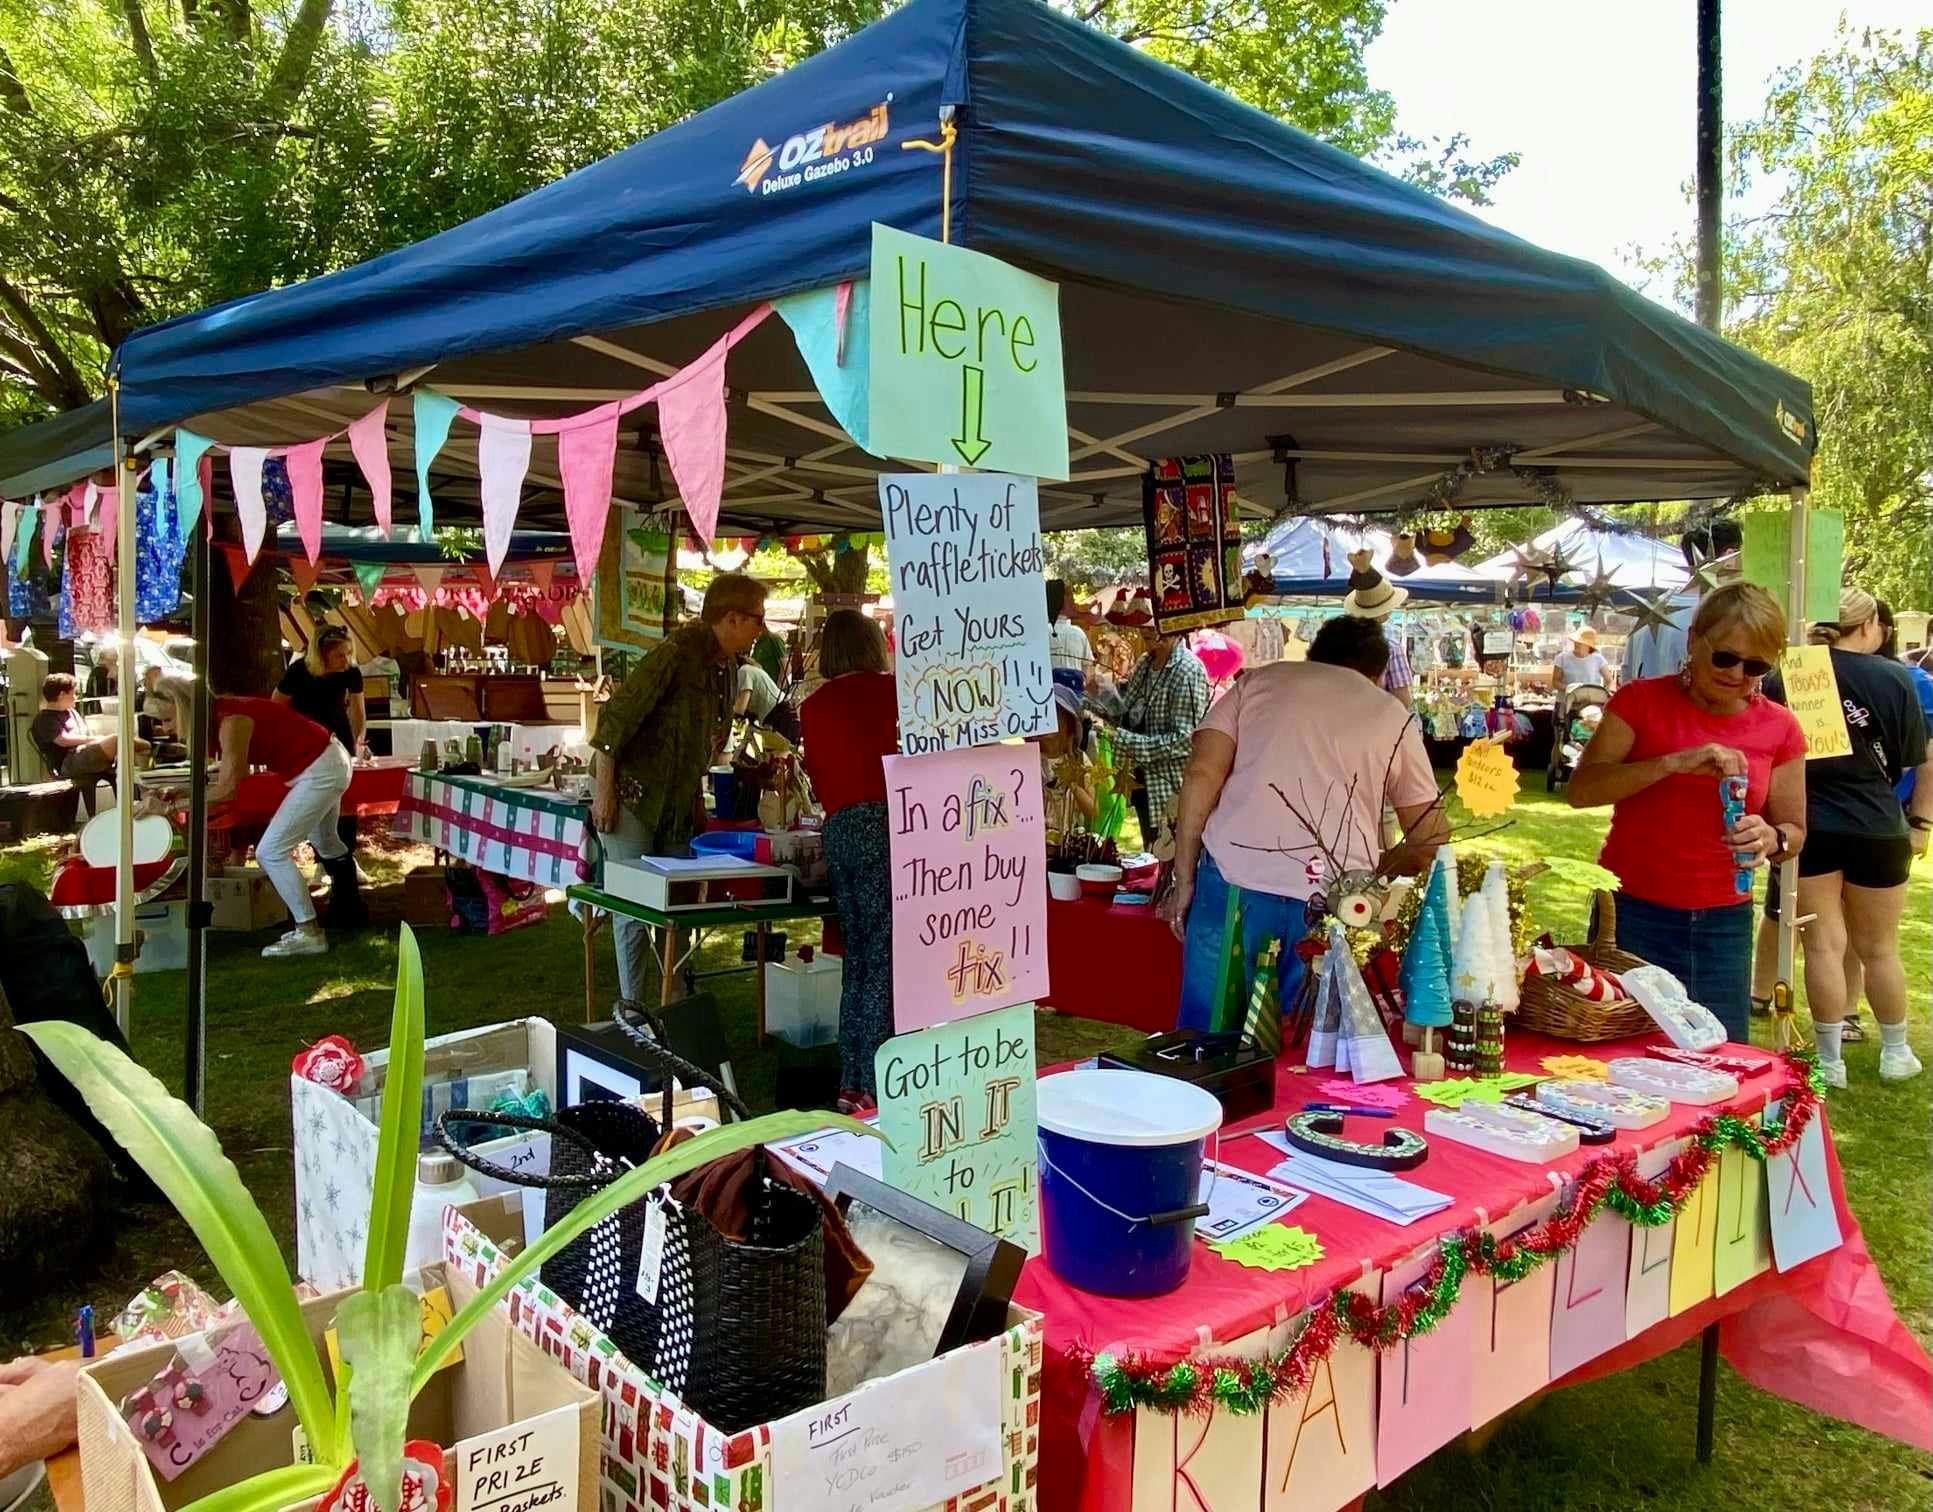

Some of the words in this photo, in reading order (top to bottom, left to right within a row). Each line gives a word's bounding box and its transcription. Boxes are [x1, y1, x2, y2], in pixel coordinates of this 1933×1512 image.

[778, 94, 894, 172] OZtrail
[762, 172, 802, 195] Deluxe
[804, 158, 851, 183] Gazebo
[852, 147, 874, 166] 3.0
[899, 256, 1039, 372] Here
[886, 483, 978, 557] Plenty
[989, 483, 1017, 532] of
[900, 541, 979, 598] raffle
[901, 614, 945, 659] Get
[957, 721, 1000, 746] Miss
[895, 786, 928, 835] In
[942, 793, 961, 832] a
[984, 844, 1027, 907] buy
[920, 904, 997, 947] some
[885, 1043, 952, 1100] Got
[957, 1036, 990, 1076] to
[995, 1028, 1029, 1069] be
[917, 1096, 965, 1163] IN
[978, 1076, 1021, 1141] IT
[510, 1147, 537, 1171] 2nd
[943, 1158, 976, 1195] to
[807, 1402, 853, 1442] FIRST
[169, 1441, 193, 1466] C
[470, 1431, 534, 1473] FIRST
[474, 1457, 545, 1502] PRIZE
